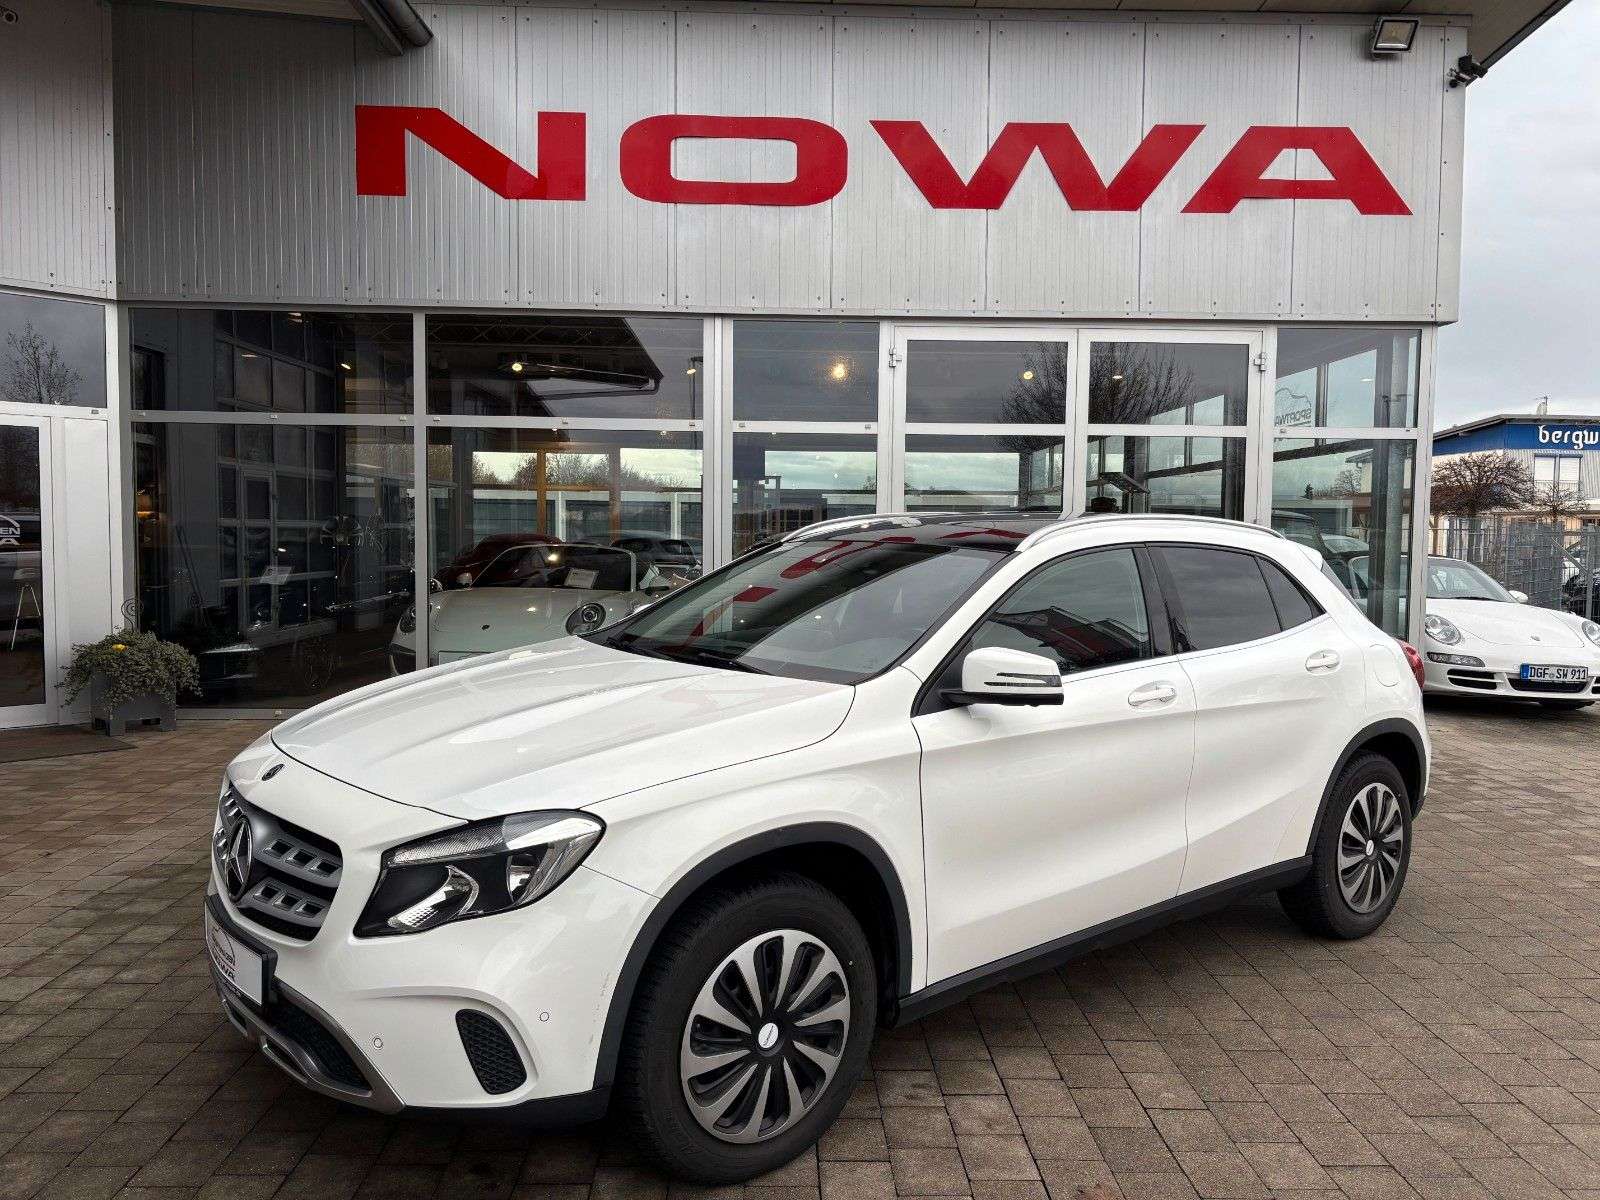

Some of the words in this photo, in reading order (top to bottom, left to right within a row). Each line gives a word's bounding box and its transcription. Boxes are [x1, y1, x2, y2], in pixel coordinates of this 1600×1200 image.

[355, 105, 1413, 215] NOWA
[1538, 424, 1599, 450] bergw
[1529, 667, 1549, 678] DGF
[1556, 669, 1568, 679] SW
[1571, 668, 1586, 680] 911
